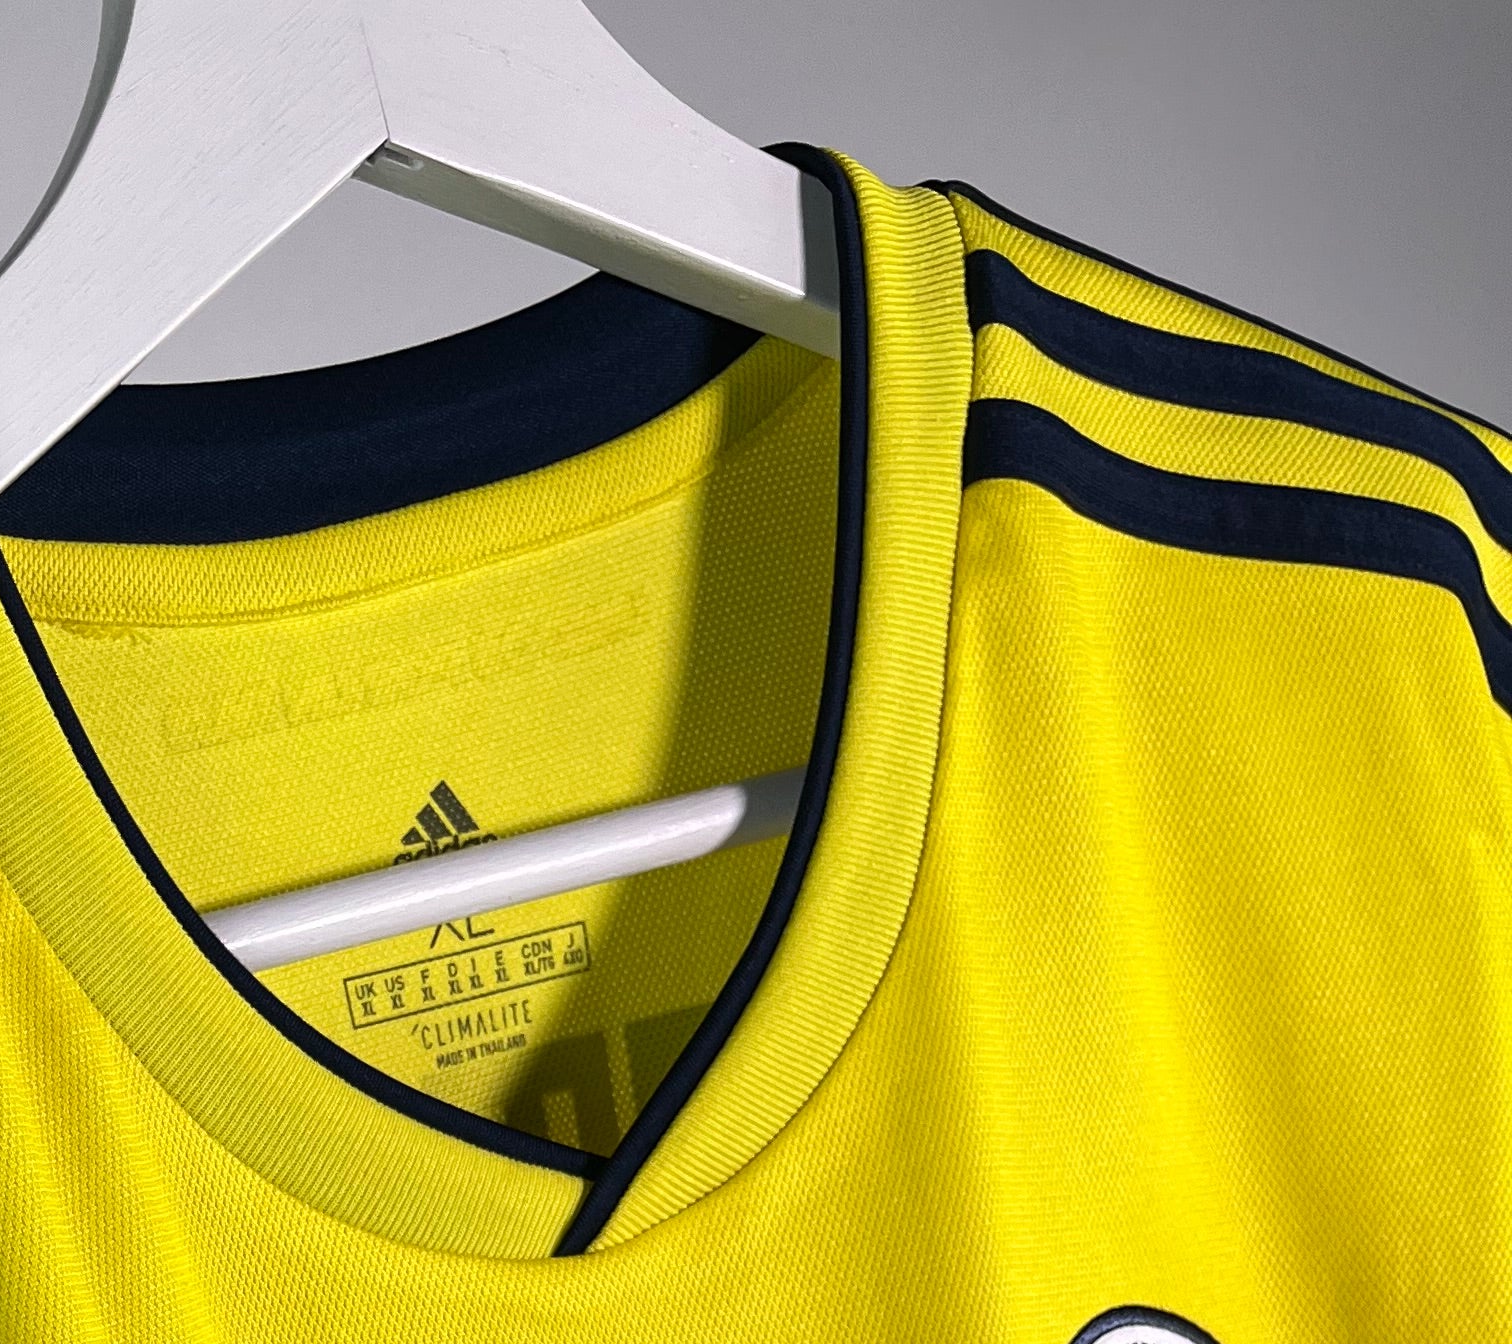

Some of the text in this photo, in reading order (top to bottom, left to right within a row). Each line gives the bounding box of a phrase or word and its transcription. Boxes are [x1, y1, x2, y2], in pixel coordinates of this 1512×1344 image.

[354, 982, 377, 1000] UK
[384, 975, 405, 993] US
[420, 968, 429, 984] F
[448, 963, 458, 977] D
[495, 950, 504, 966] E
[521, 938, 552, 959] CDN
[567, 932, 574, 948] J
[361, 1001, 376, 1017] XL
[391, 994, 405, 1010] XL
[421, 986, 436, 1002] XL
[448, 980, 463, 995] XL
[469, 974, 484, 990] XL
[495, 967, 509, 983] XL
[436, 1033, 526, 1069] MADE IN THAILAND
